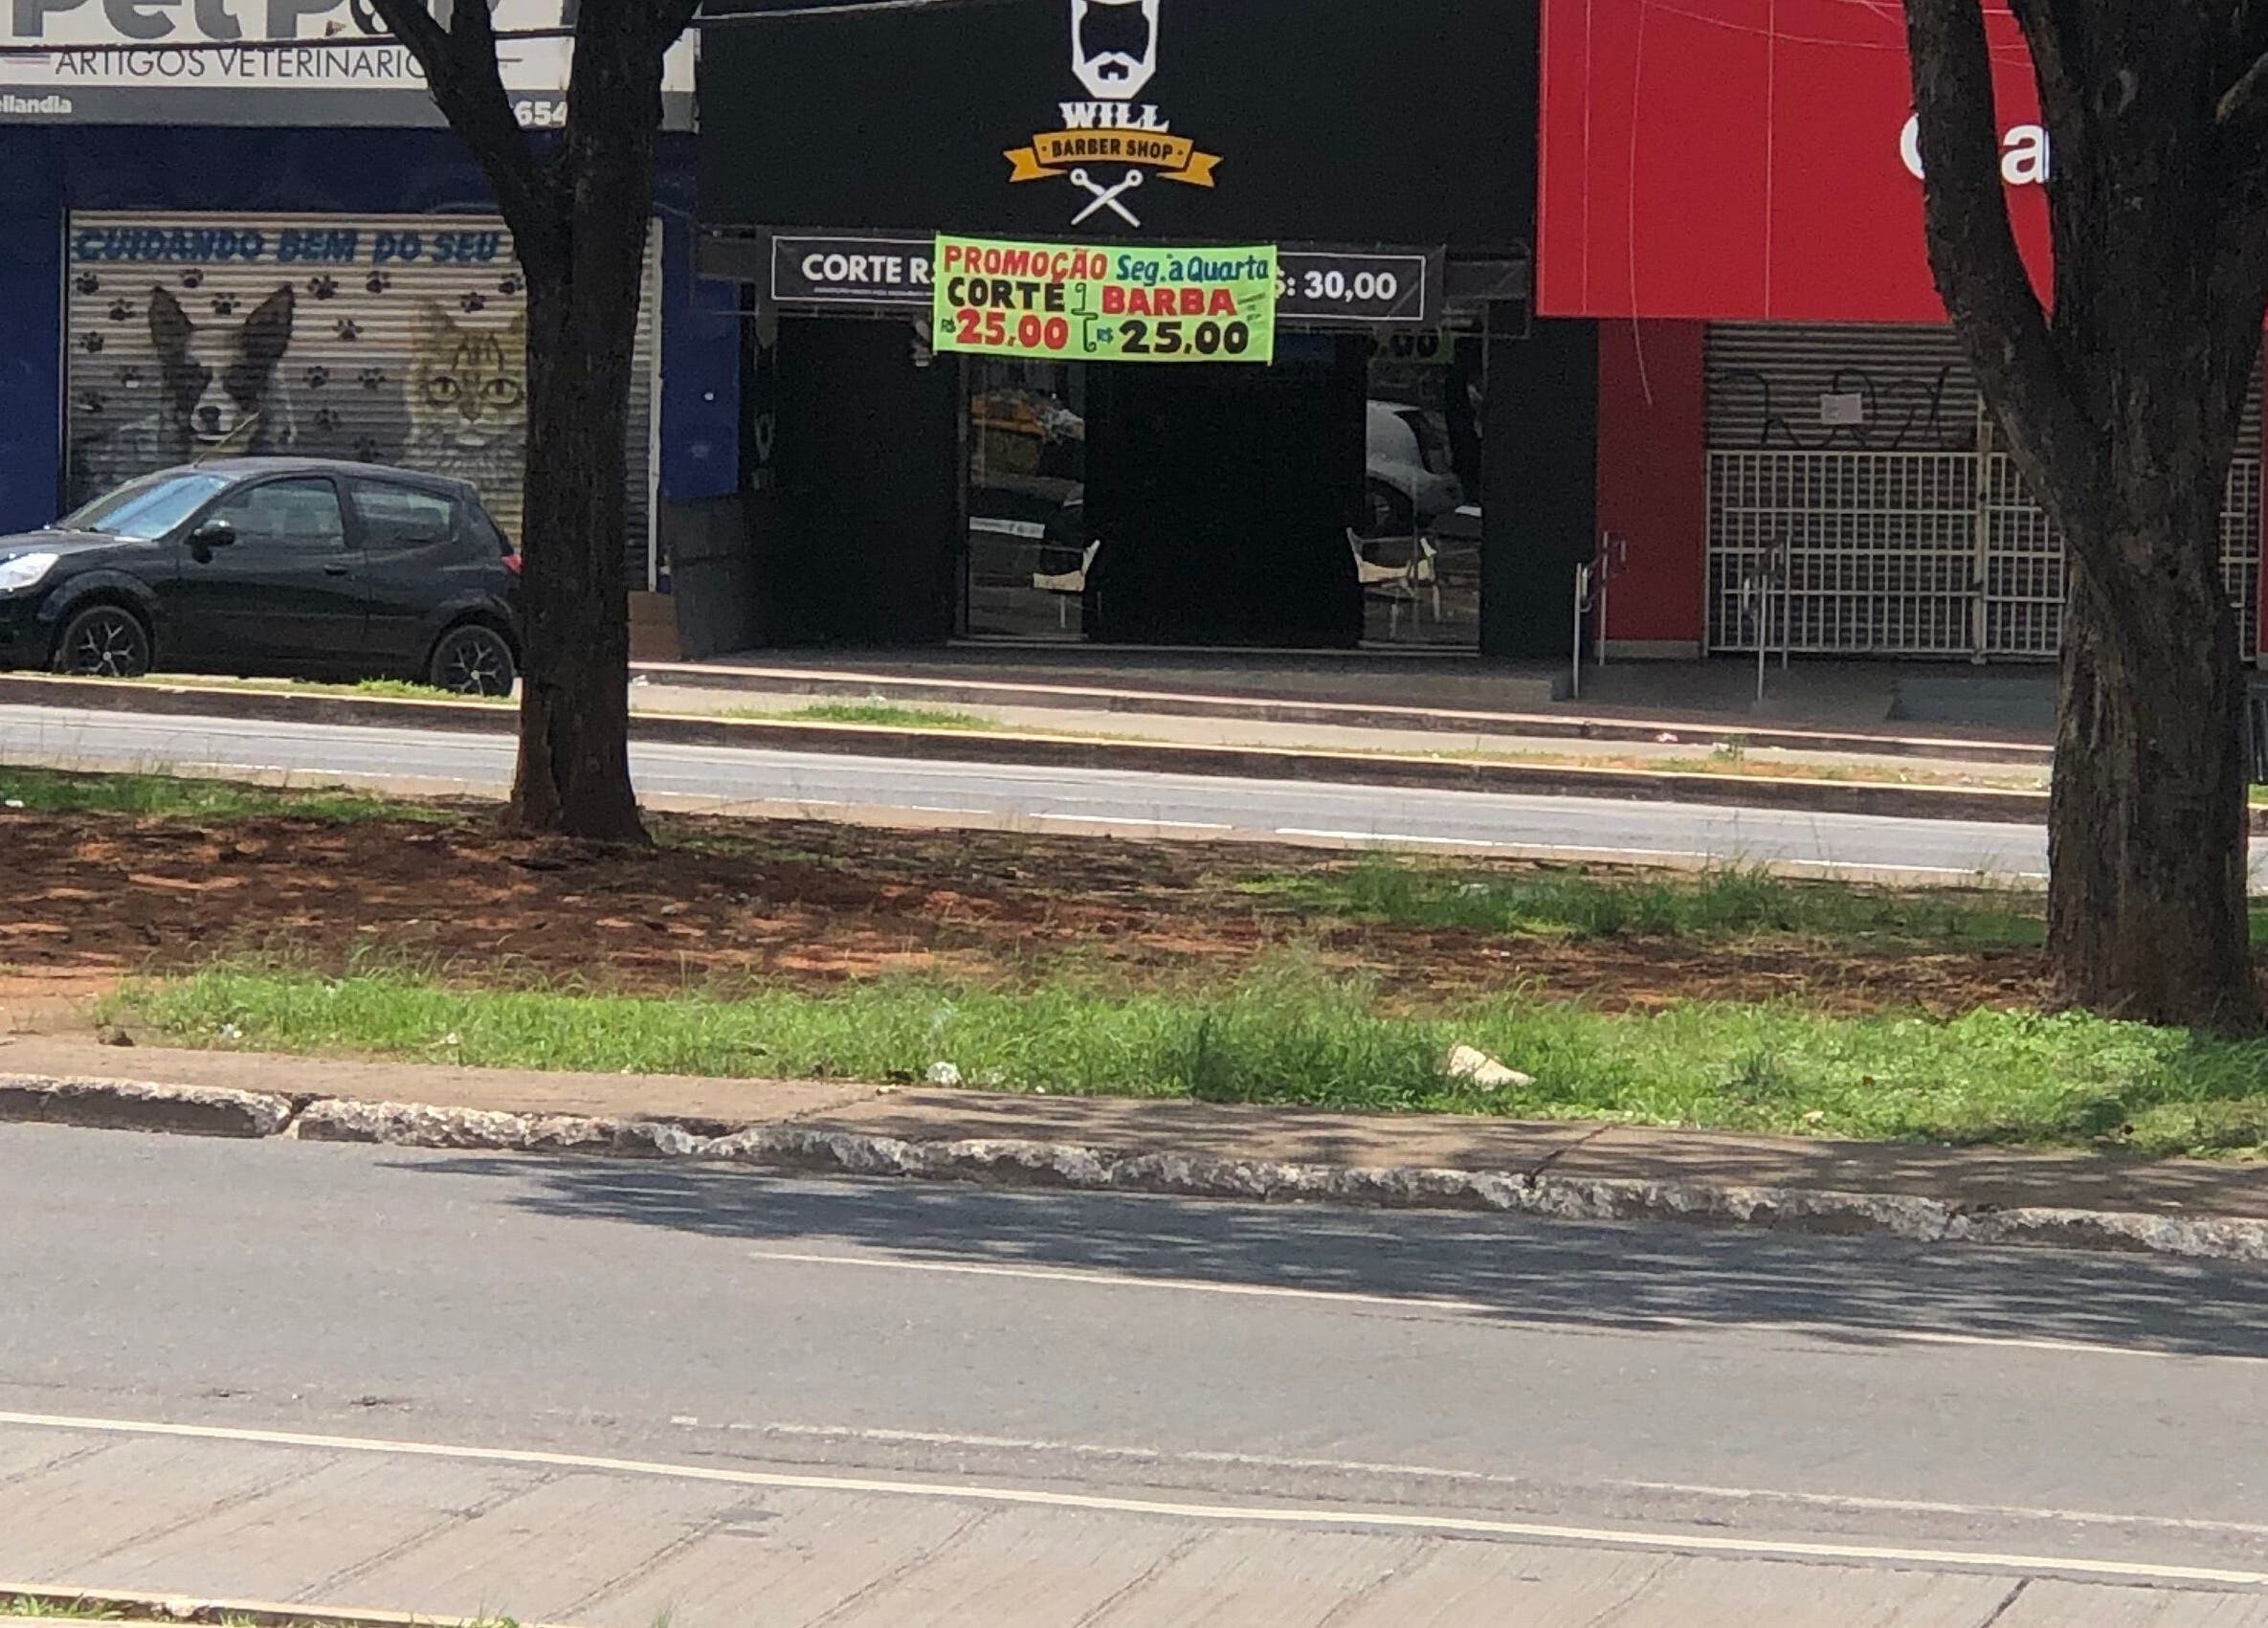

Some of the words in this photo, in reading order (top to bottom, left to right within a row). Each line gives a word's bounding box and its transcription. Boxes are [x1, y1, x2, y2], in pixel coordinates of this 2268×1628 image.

[55, 49, 205, 77] ARTIGOS
[1058, 101, 1169, 132] WILL
[1052, 139, 1121, 158] BARBER
[1126, 141, 1173, 160] SHOP
[76, 227, 264, 259] CUIDANDO
[278, 228, 359, 261] BEM
[374, 229, 422, 264] DO
[433, 230, 500, 261] SEU
[802, 254, 901, 283] CORTE
[944, 245, 1108, 283] PROMOÇÃO
[1116, 254, 1167, 286] Seg.
[1188, 256, 1269, 282] Quarta
[948, 277, 1065, 312] CORTE
[1102, 285, 1236, 317] BARBA
[1304, 271, 1397, 302] 30,00
